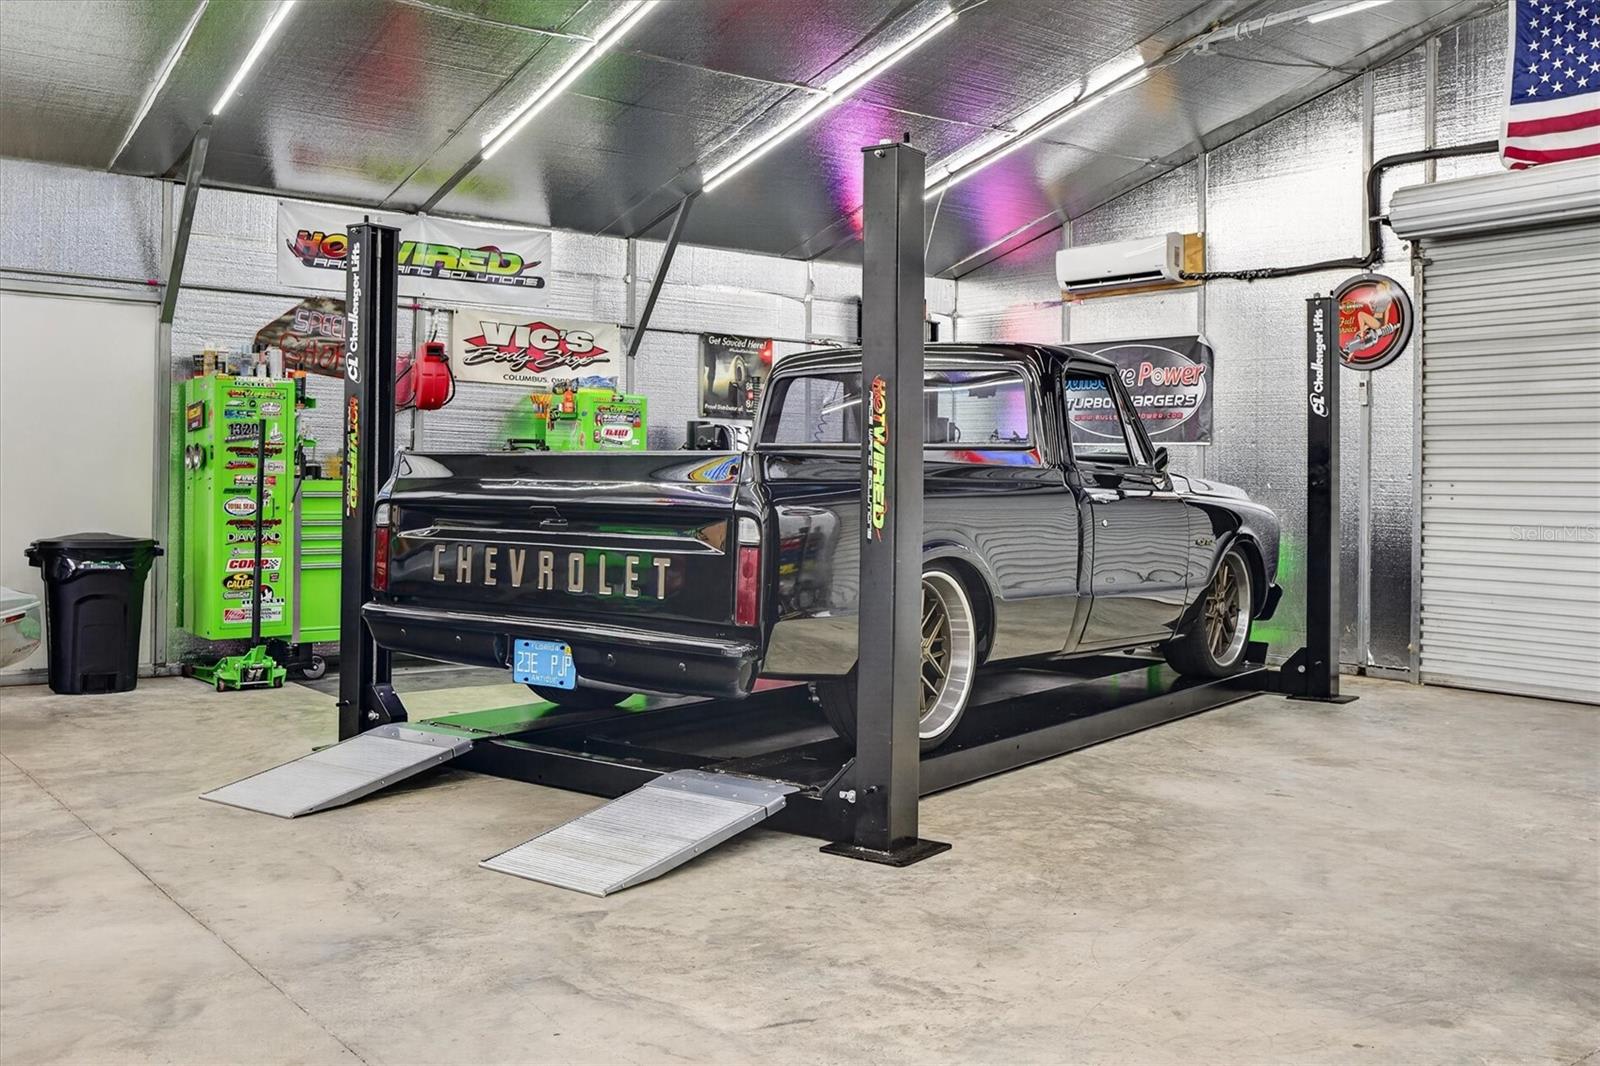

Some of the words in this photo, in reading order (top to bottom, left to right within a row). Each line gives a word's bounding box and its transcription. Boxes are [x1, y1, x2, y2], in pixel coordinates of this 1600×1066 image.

[350, 242, 361, 272] Lifts
[438, 269, 539, 287] SOLUTIONS
[293, 308, 346, 339] SPEE
[347, 274, 362, 352] Challenger
[1313, 308, 1324, 332] Lifts
[479, 321, 595, 353] VIC'S
[708, 335, 721, 345] Get
[721, 337, 747, 348] Sauced
[747, 339, 767, 350] Here!
[463, 346, 534, 372] Body
[535, 349, 611, 371] Shop
[1311, 332, 1327, 393] Challenger
[1137, 361, 1207, 388] Power
[872, 376, 888, 530] HOTWIRED
[432, 543, 671, 600] CHEVROLET
[550, 654, 572, 677] PJP
